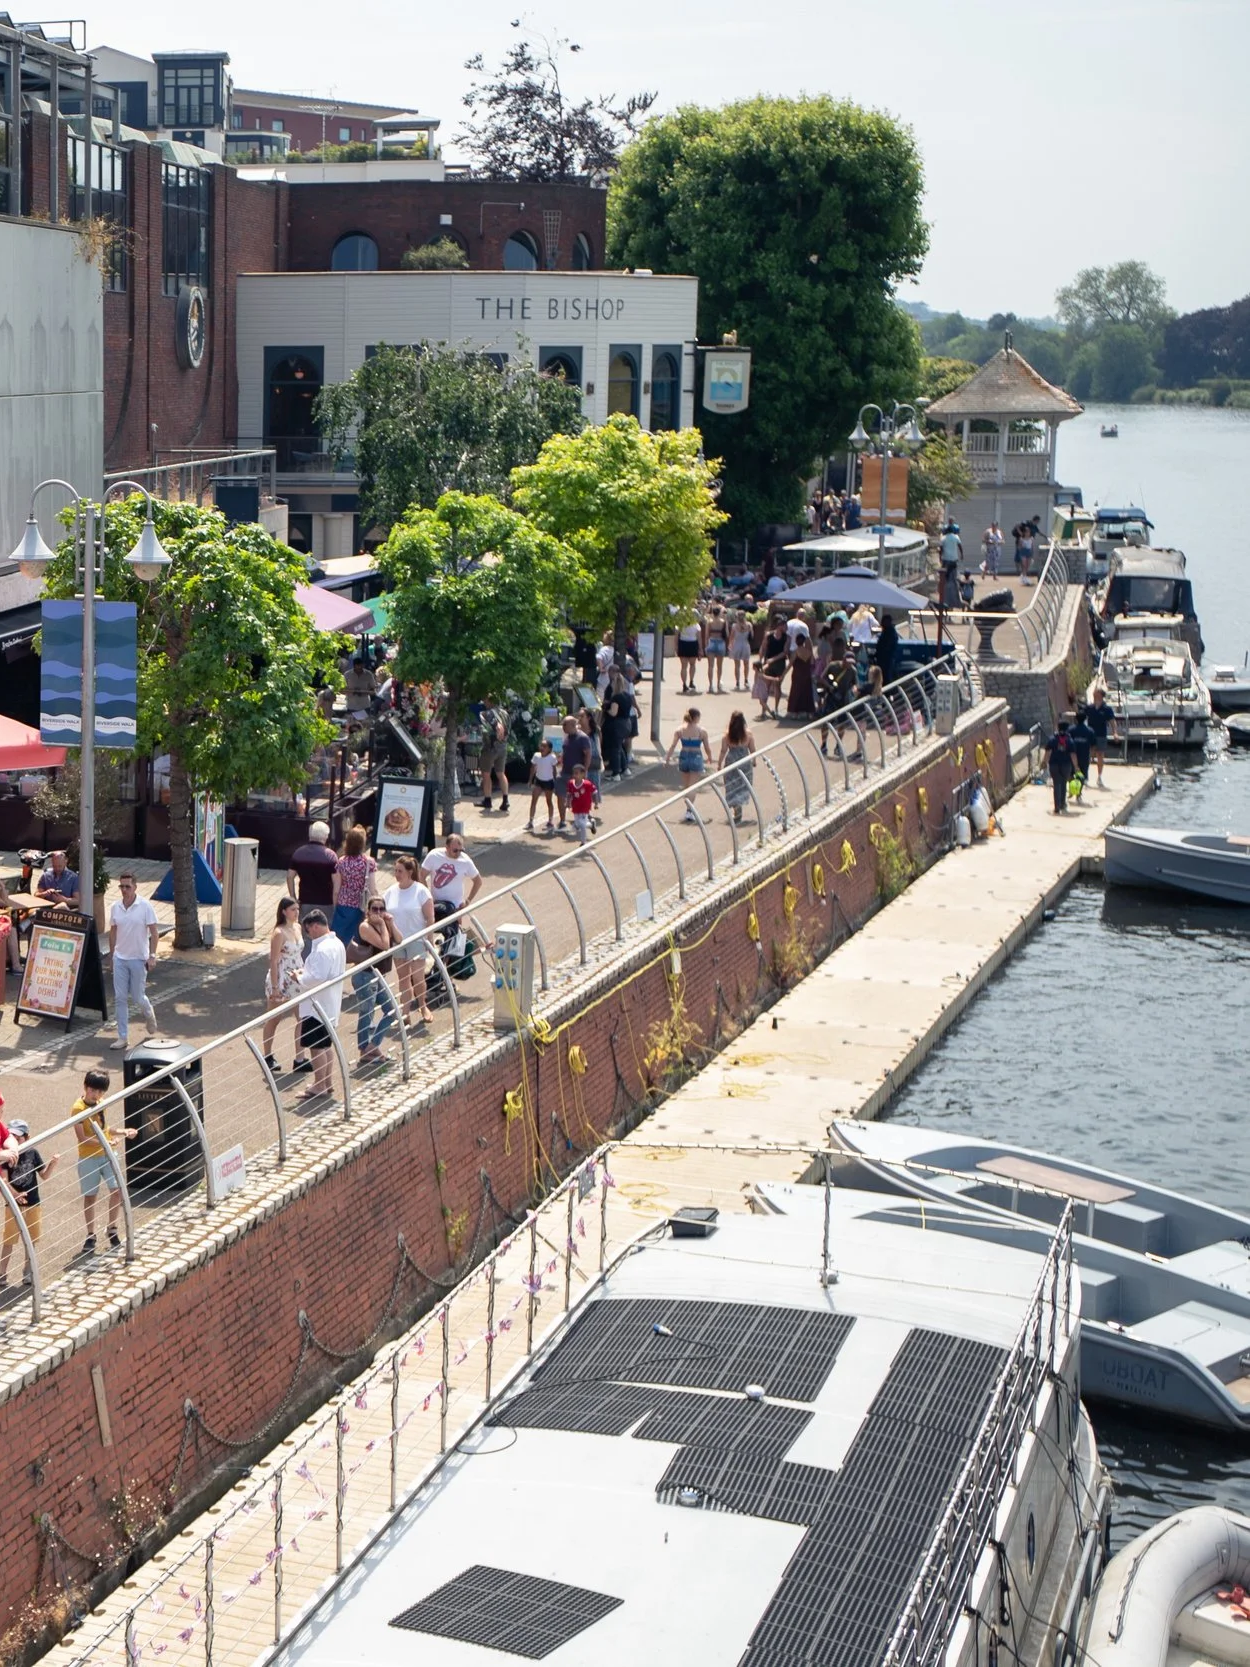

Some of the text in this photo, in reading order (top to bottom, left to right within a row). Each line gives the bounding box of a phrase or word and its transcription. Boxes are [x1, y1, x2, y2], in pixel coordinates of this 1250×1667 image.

[475, 297, 625, 321] THE BISHOP
[42, 911, 82, 924] COMPTOIR
[44, 957, 64, 968] TRYING
[36, 966, 48, 975] OUR
[49, 968, 62, 977] NEW
[36, 976, 63, 989] EXCITING
[38, 987, 57, 997] DISHES
